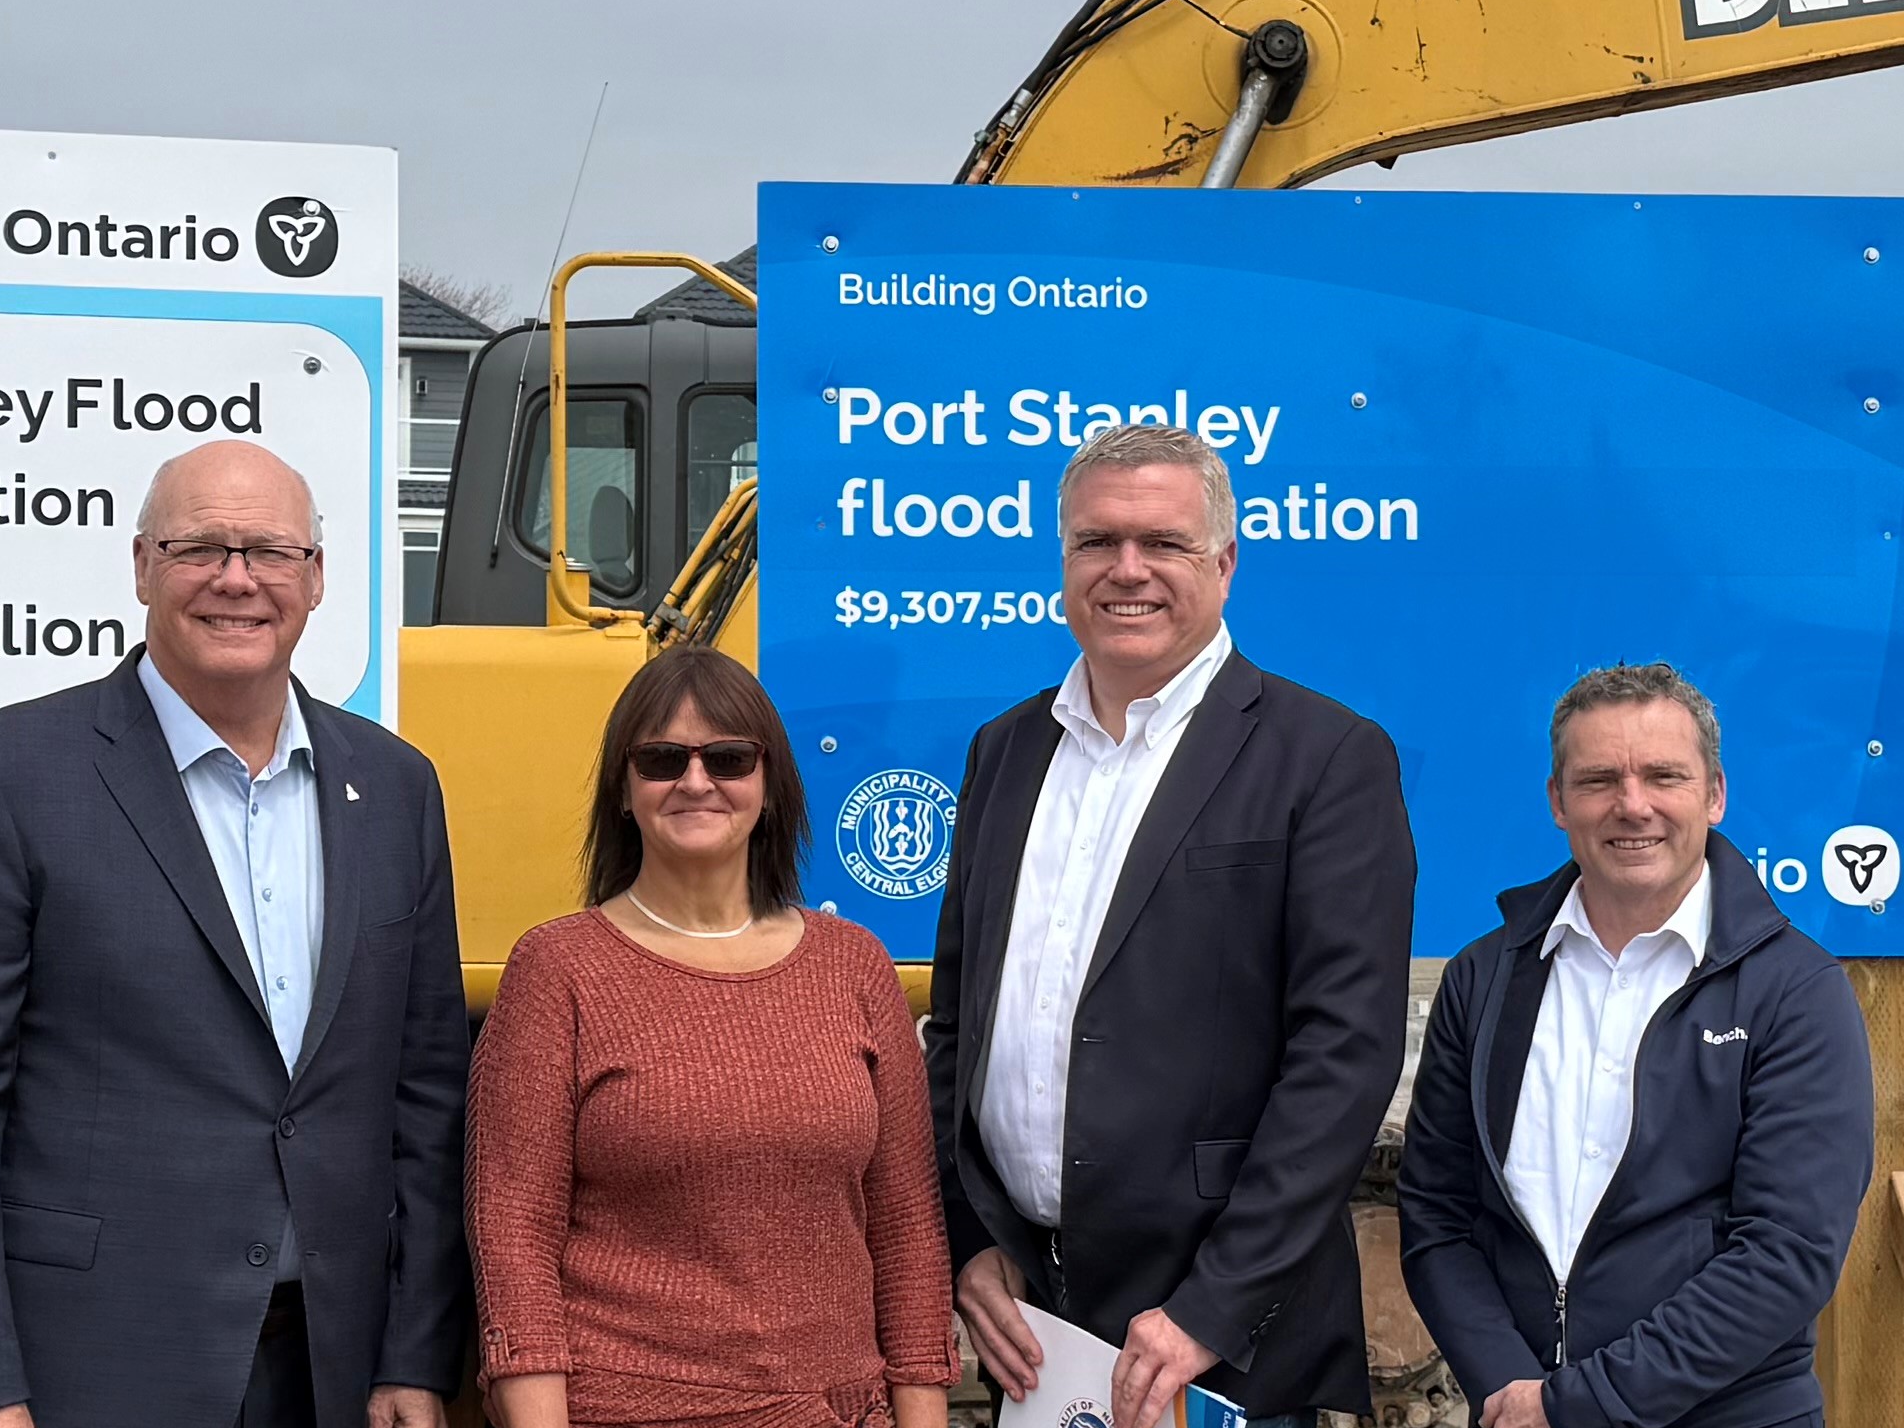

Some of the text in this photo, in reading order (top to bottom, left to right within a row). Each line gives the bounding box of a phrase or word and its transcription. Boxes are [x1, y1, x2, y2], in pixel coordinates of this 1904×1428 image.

[3, 209, 239, 262] Ontario
[839, 273, 1148, 316] Building Ontario
[67, 378, 262, 434] Flood
[839, 387, 1281, 465] Port Stanley
[837, 477, 1033, 538] flood
[835, 585, 1067, 630] $9,307,500
[841, 773, 950, 831] MUNICIPALITY
[846, 852, 915, 895] CENTRAL
[1080, 1400, 1094, 1412] OF
